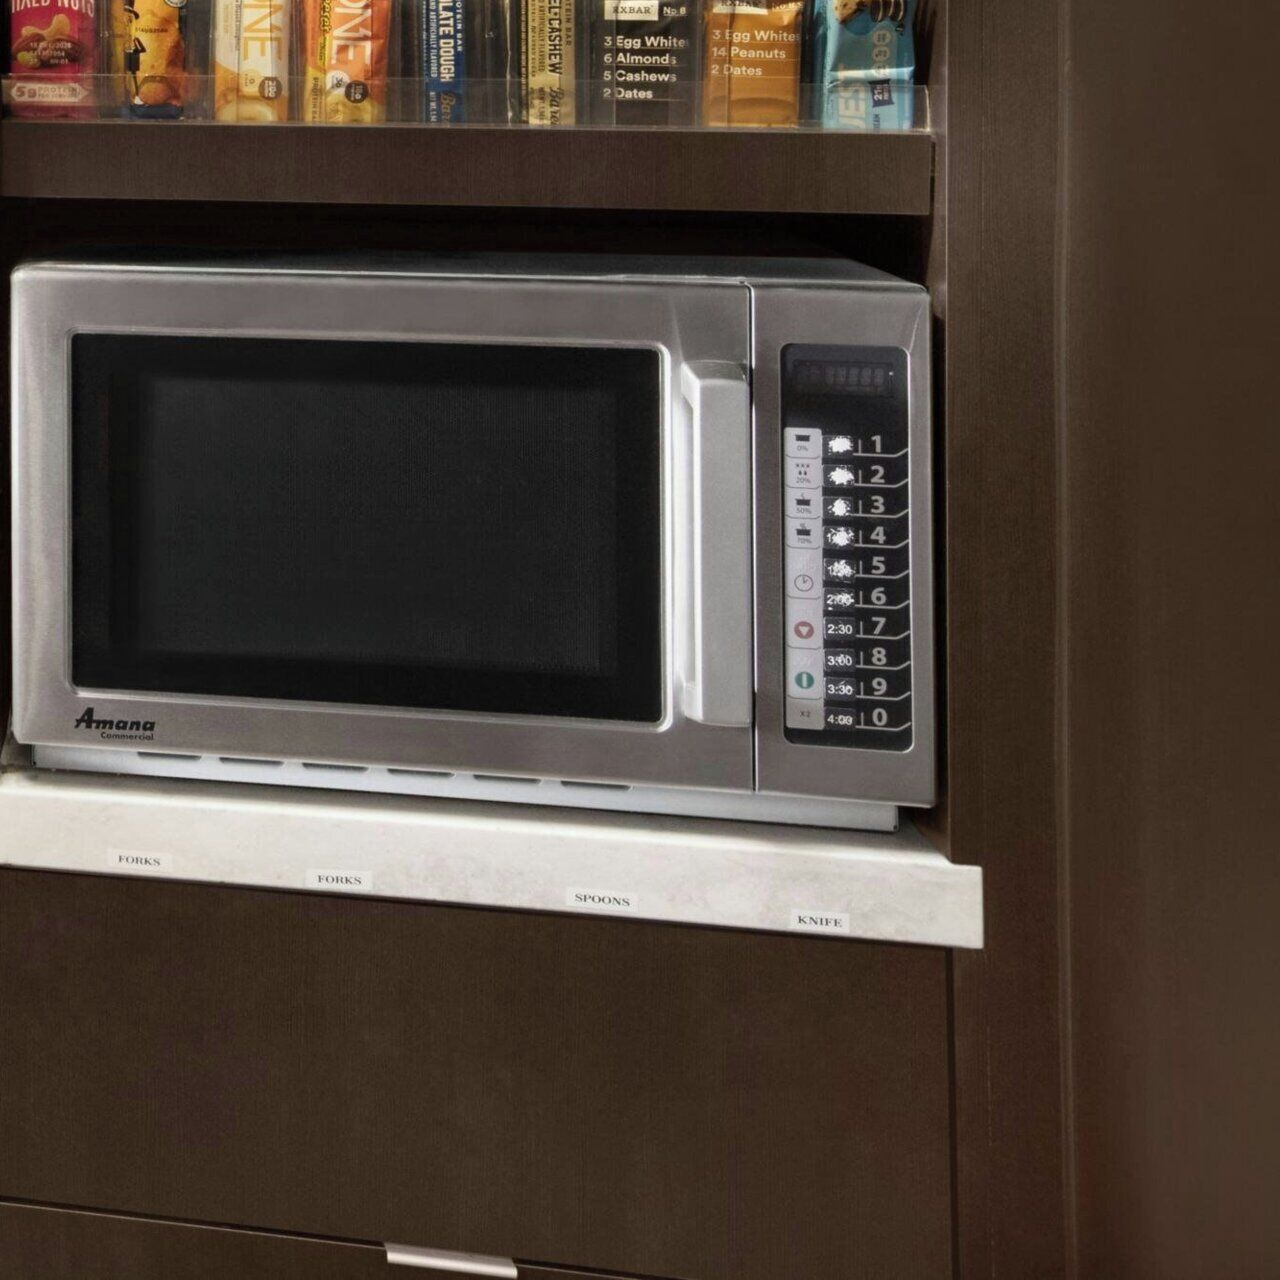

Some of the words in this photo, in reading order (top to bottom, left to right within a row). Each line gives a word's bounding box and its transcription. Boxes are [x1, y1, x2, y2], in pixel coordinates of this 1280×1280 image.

[604, 36, 613, 47] 3
[616, 35, 641, 48] Egg
[712, 30, 720, 40] 3
[724, 30, 750, 44] Egg
[604, 53, 613, 63] 6
[616, 52, 677, 64] Almonds
[712, 47, 725, 57] 14
[730, 46, 785, 59] Peanuts
[440, 38, 456, 82] DOUGH
[603, 70, 611, 80] 5
[615, 70, 677, 82] Cashews
[711, 65, 719, 74] 2
[723, 64, 762, 76] Dates
[615, 87, 653, 98] Dates
[870, 434, 882, 453] 1
[870, 465, 886, 483] 2
[870, 495, 886, 514] 3
[870, 526, 887, 544] 4
[871, 556, 886, 575] 5
[871, 587, 887, 605] 6
[827, 624, 853, 635] 2:30
[871, 616, 887, 635] 7
[827, 654, 853, 666] 3:00
[871, 647, 888, 666] 8
[827, 683, 854, 695] 3:30
[871, 677, 888, 696] 9
[74, 707, 156, 732] Amana
[827, 714, 853, 725] 4:00
[872, 707, 888, 727] 0
[100, 731, 155, 741] Commercial
[118, 854, 161, 867] FORKS
[318, 874, 362, 885] FORKS
[574, 893, 631, 907] SPOONS
[798, 914, 843, 928] KNIFE
